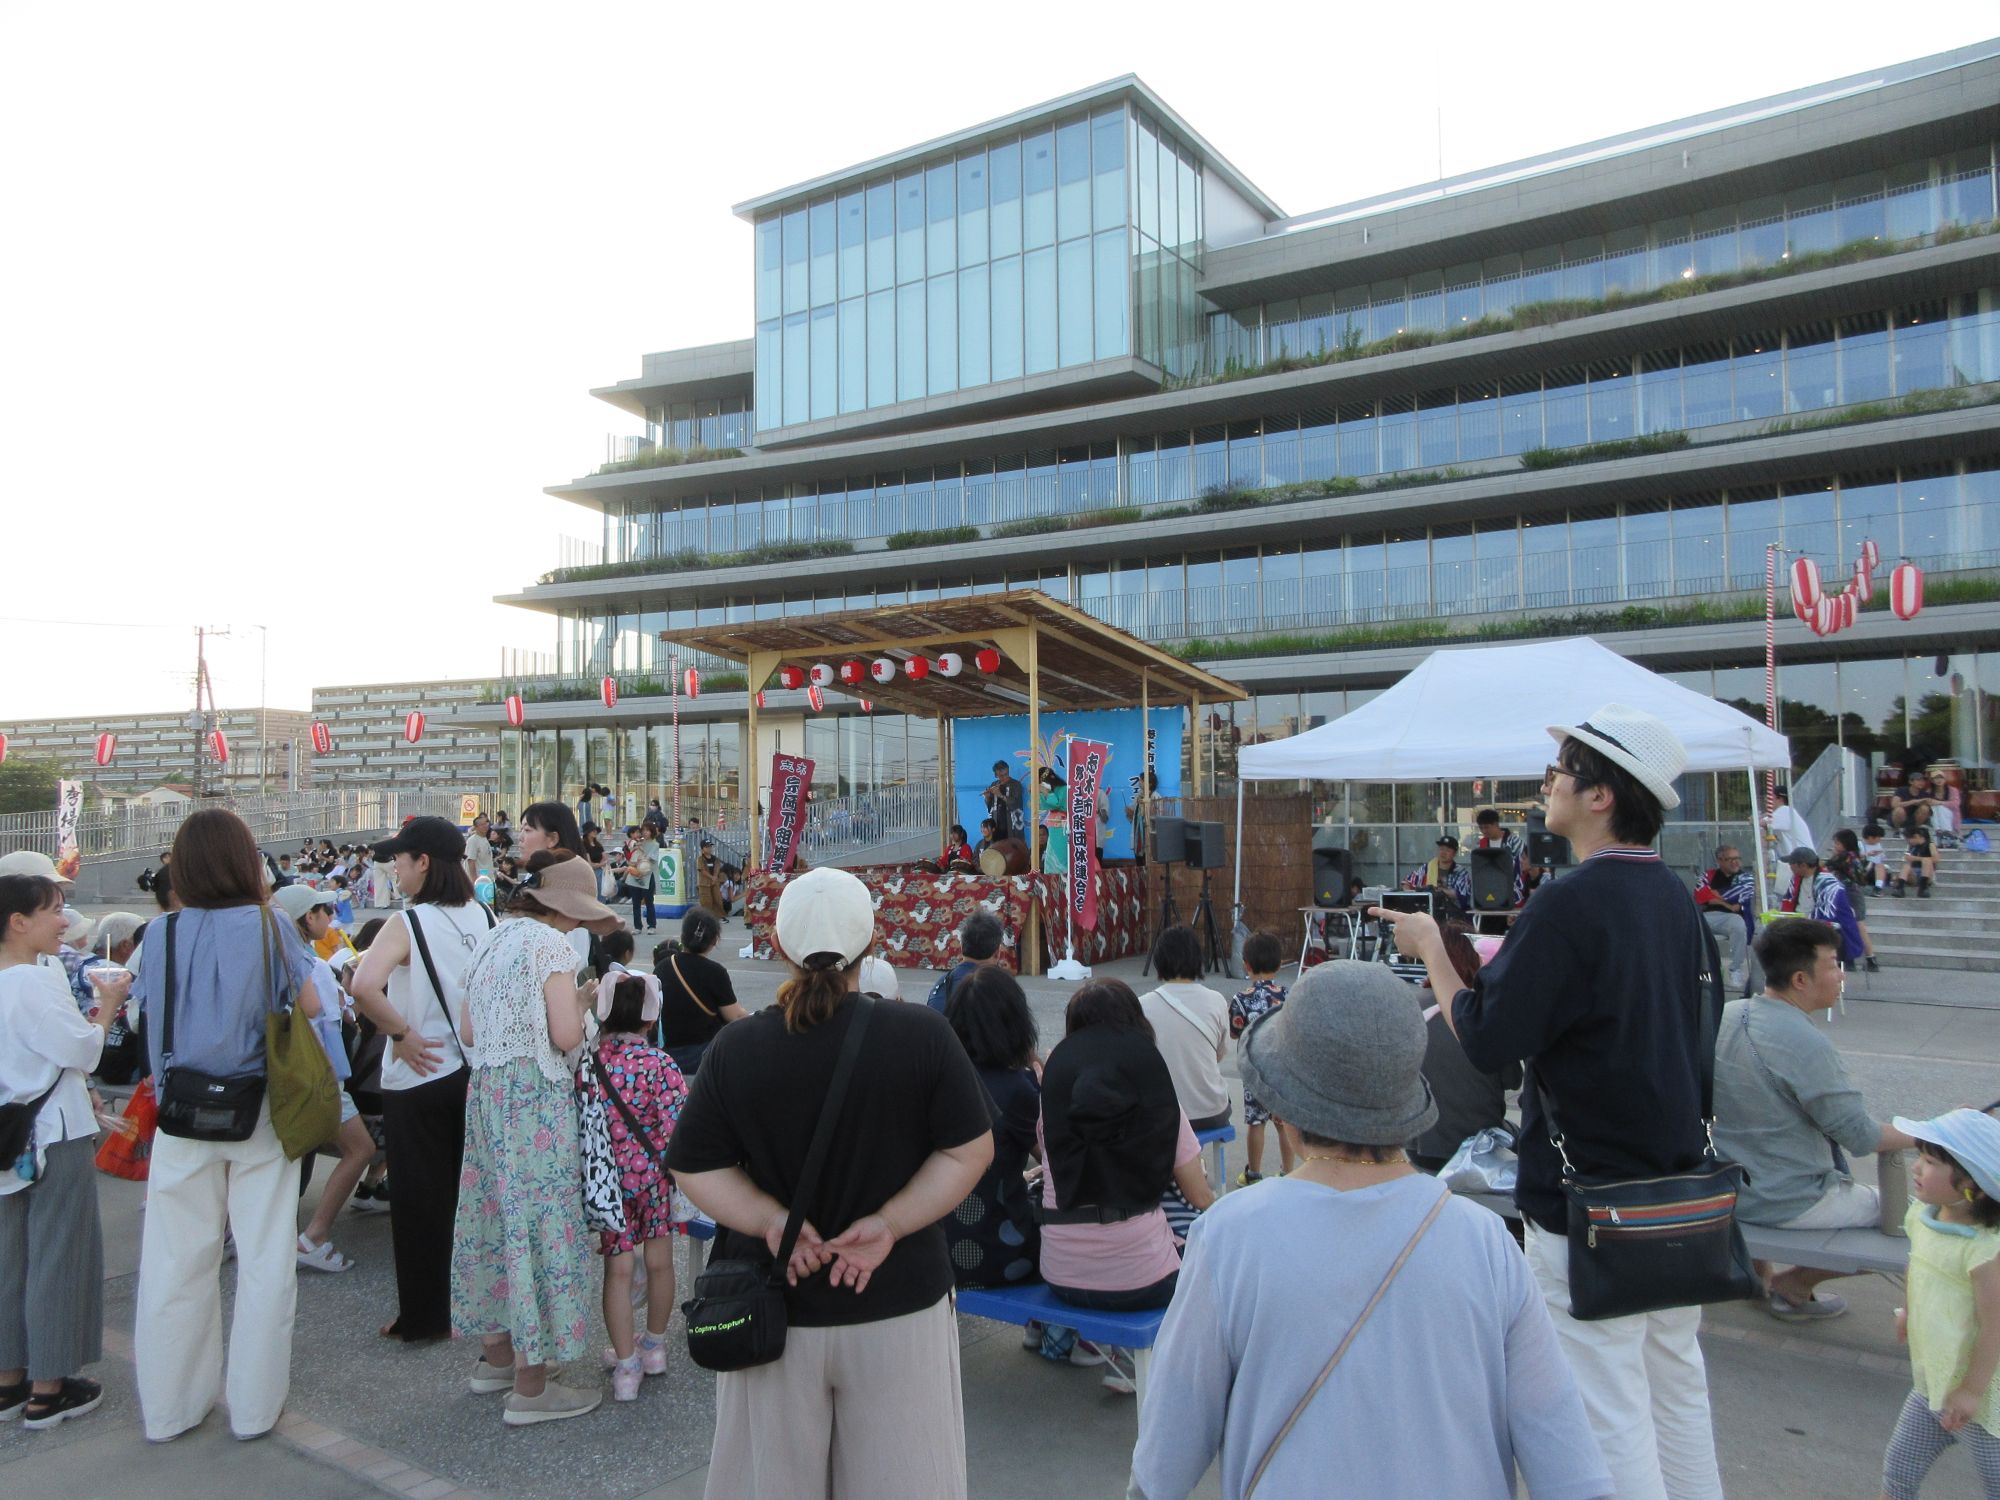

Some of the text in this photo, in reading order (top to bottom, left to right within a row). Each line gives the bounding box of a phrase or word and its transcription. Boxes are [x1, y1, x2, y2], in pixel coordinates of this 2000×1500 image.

[872, 663, 882, 675] 祭
[938, 658, 949, 671] 祭
[811, 668, 822, 680] 祭
[779, 759, 807, 776] 志木
[1083, 751, 1100, 818] 志木市
[718, 1317, 745, 1330] Capture
